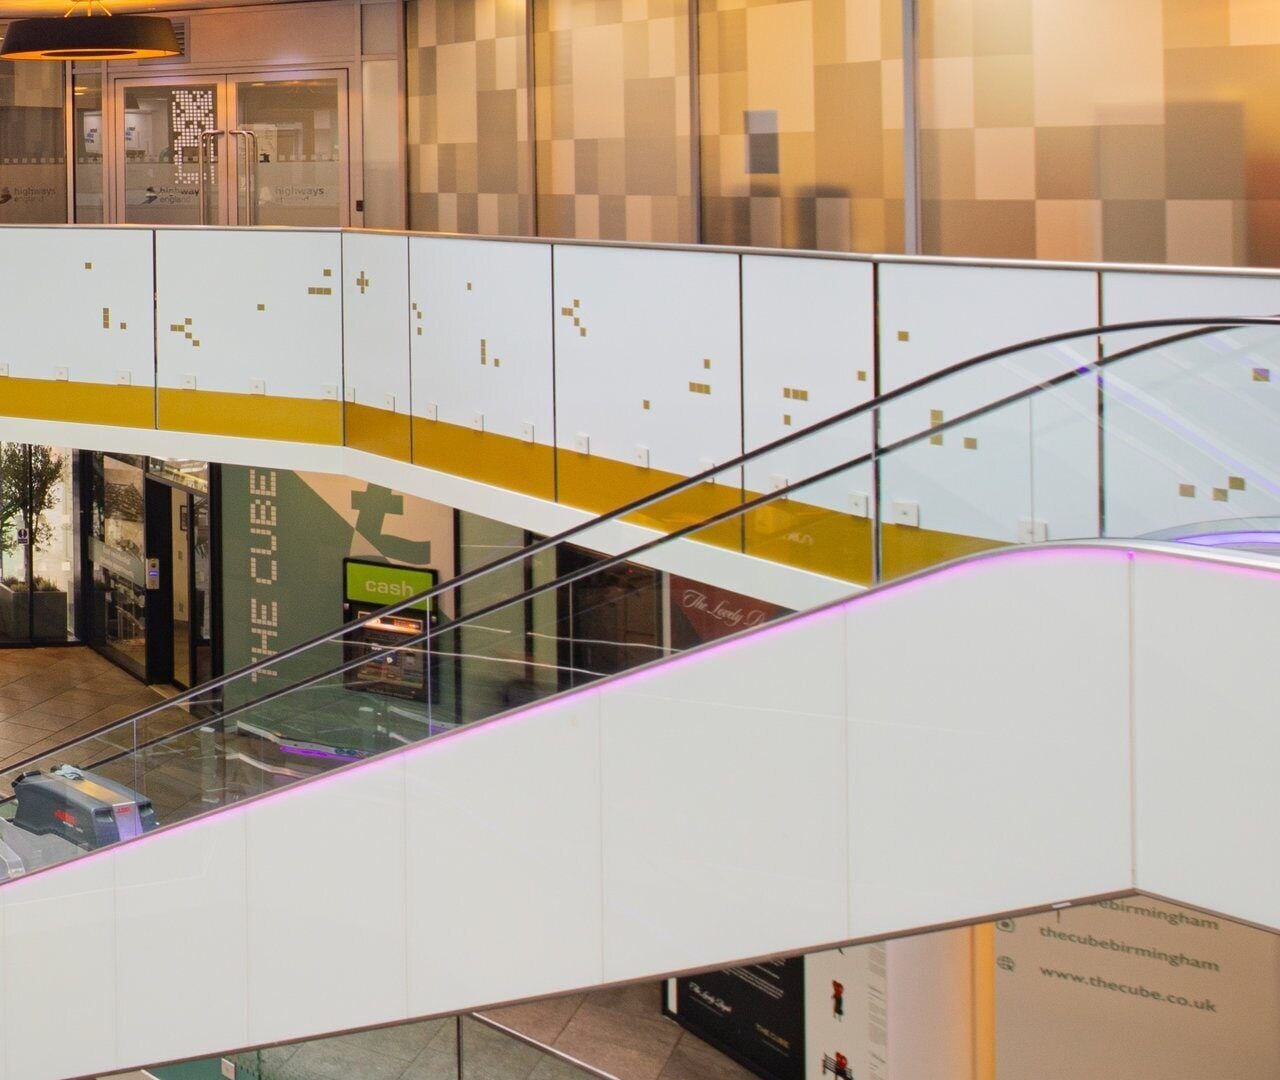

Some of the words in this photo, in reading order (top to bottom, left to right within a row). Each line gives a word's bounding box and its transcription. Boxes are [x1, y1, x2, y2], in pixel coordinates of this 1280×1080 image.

[249, 469, 277, 586] CUBE
[365, 580, 414, 597] cash
[682, 589, 709, 612] The
[707, 600, 744, 627] Lovely
[250, 598, 278, 683] THE
[1093, 899, 1219, 931] ebirmingham
[1040, 926, 1220, 972] thecubebirmingham
[1040, 966, 1217, 1013] www.thecube.co.uk
